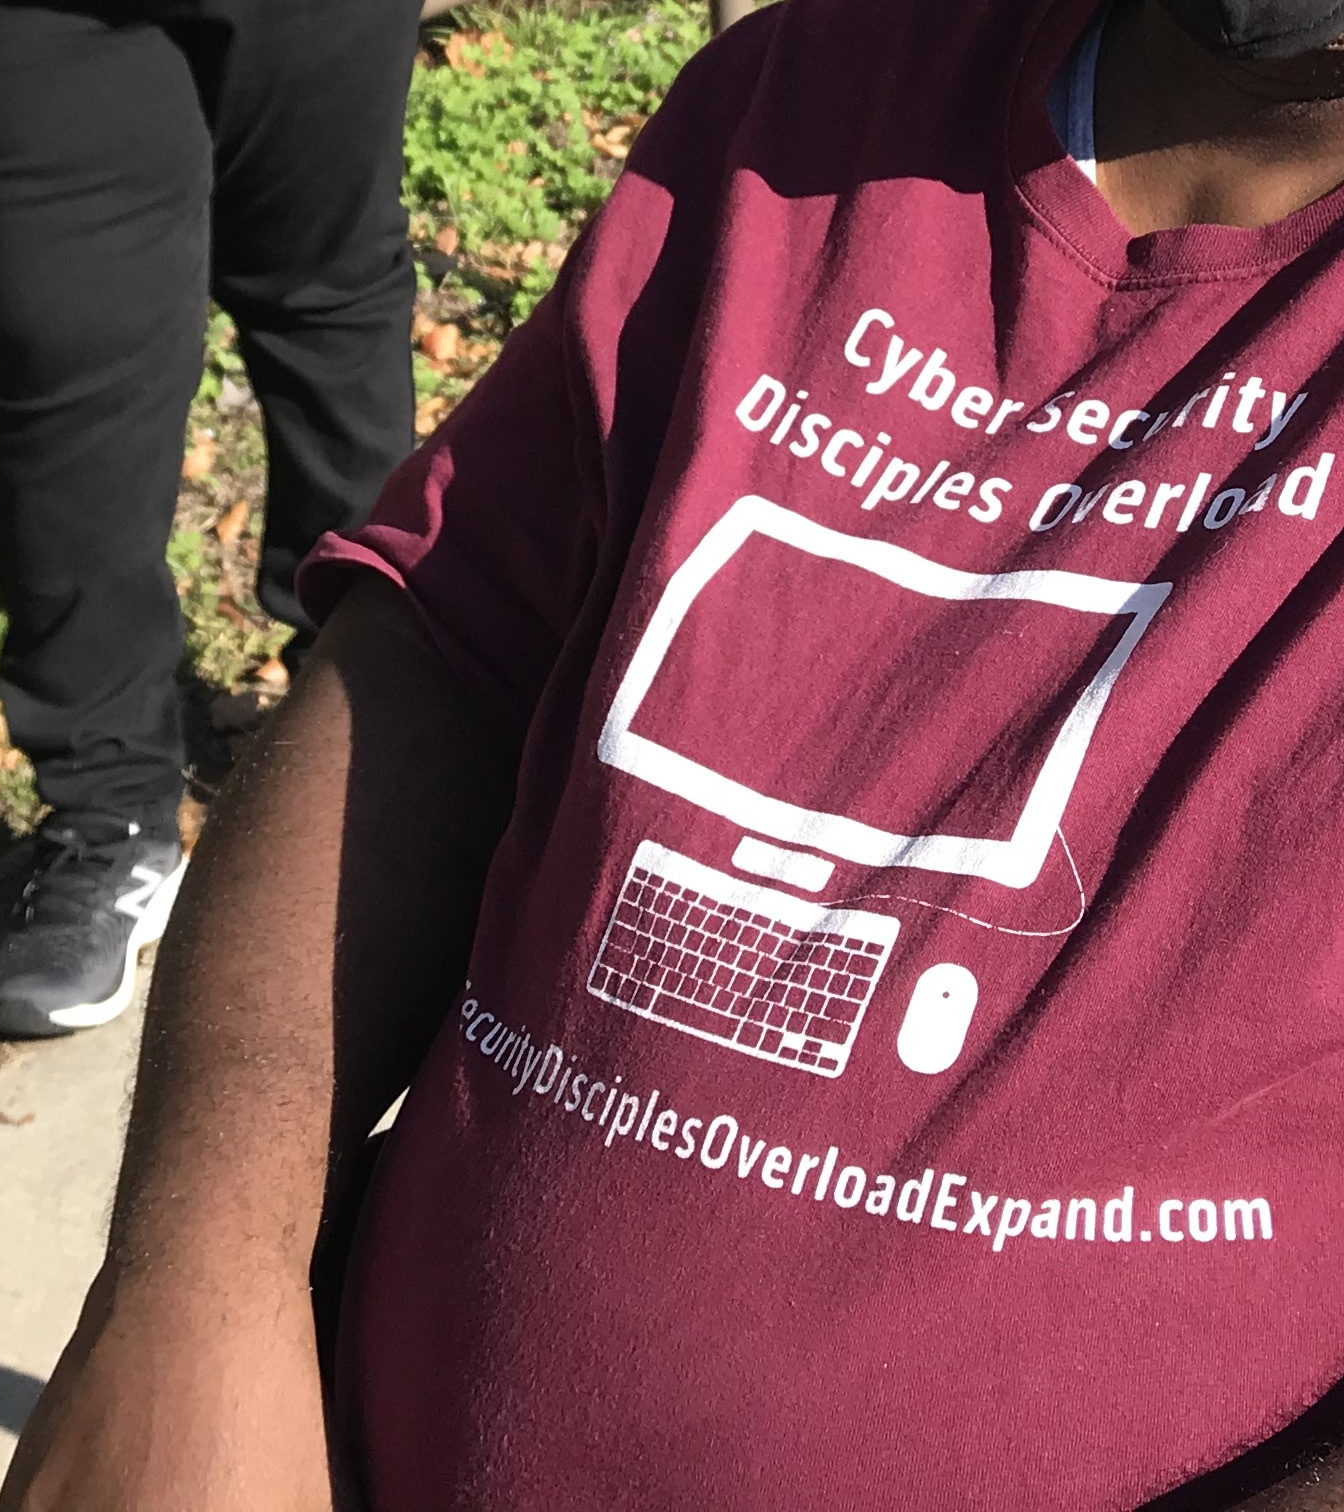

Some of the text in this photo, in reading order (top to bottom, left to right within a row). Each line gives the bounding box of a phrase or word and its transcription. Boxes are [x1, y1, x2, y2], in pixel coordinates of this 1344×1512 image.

[735, 374, 1335, 534] Disciples Overload
[460, 978, 1273, 1252] ecurityDisciplesOverloadExpand.com
